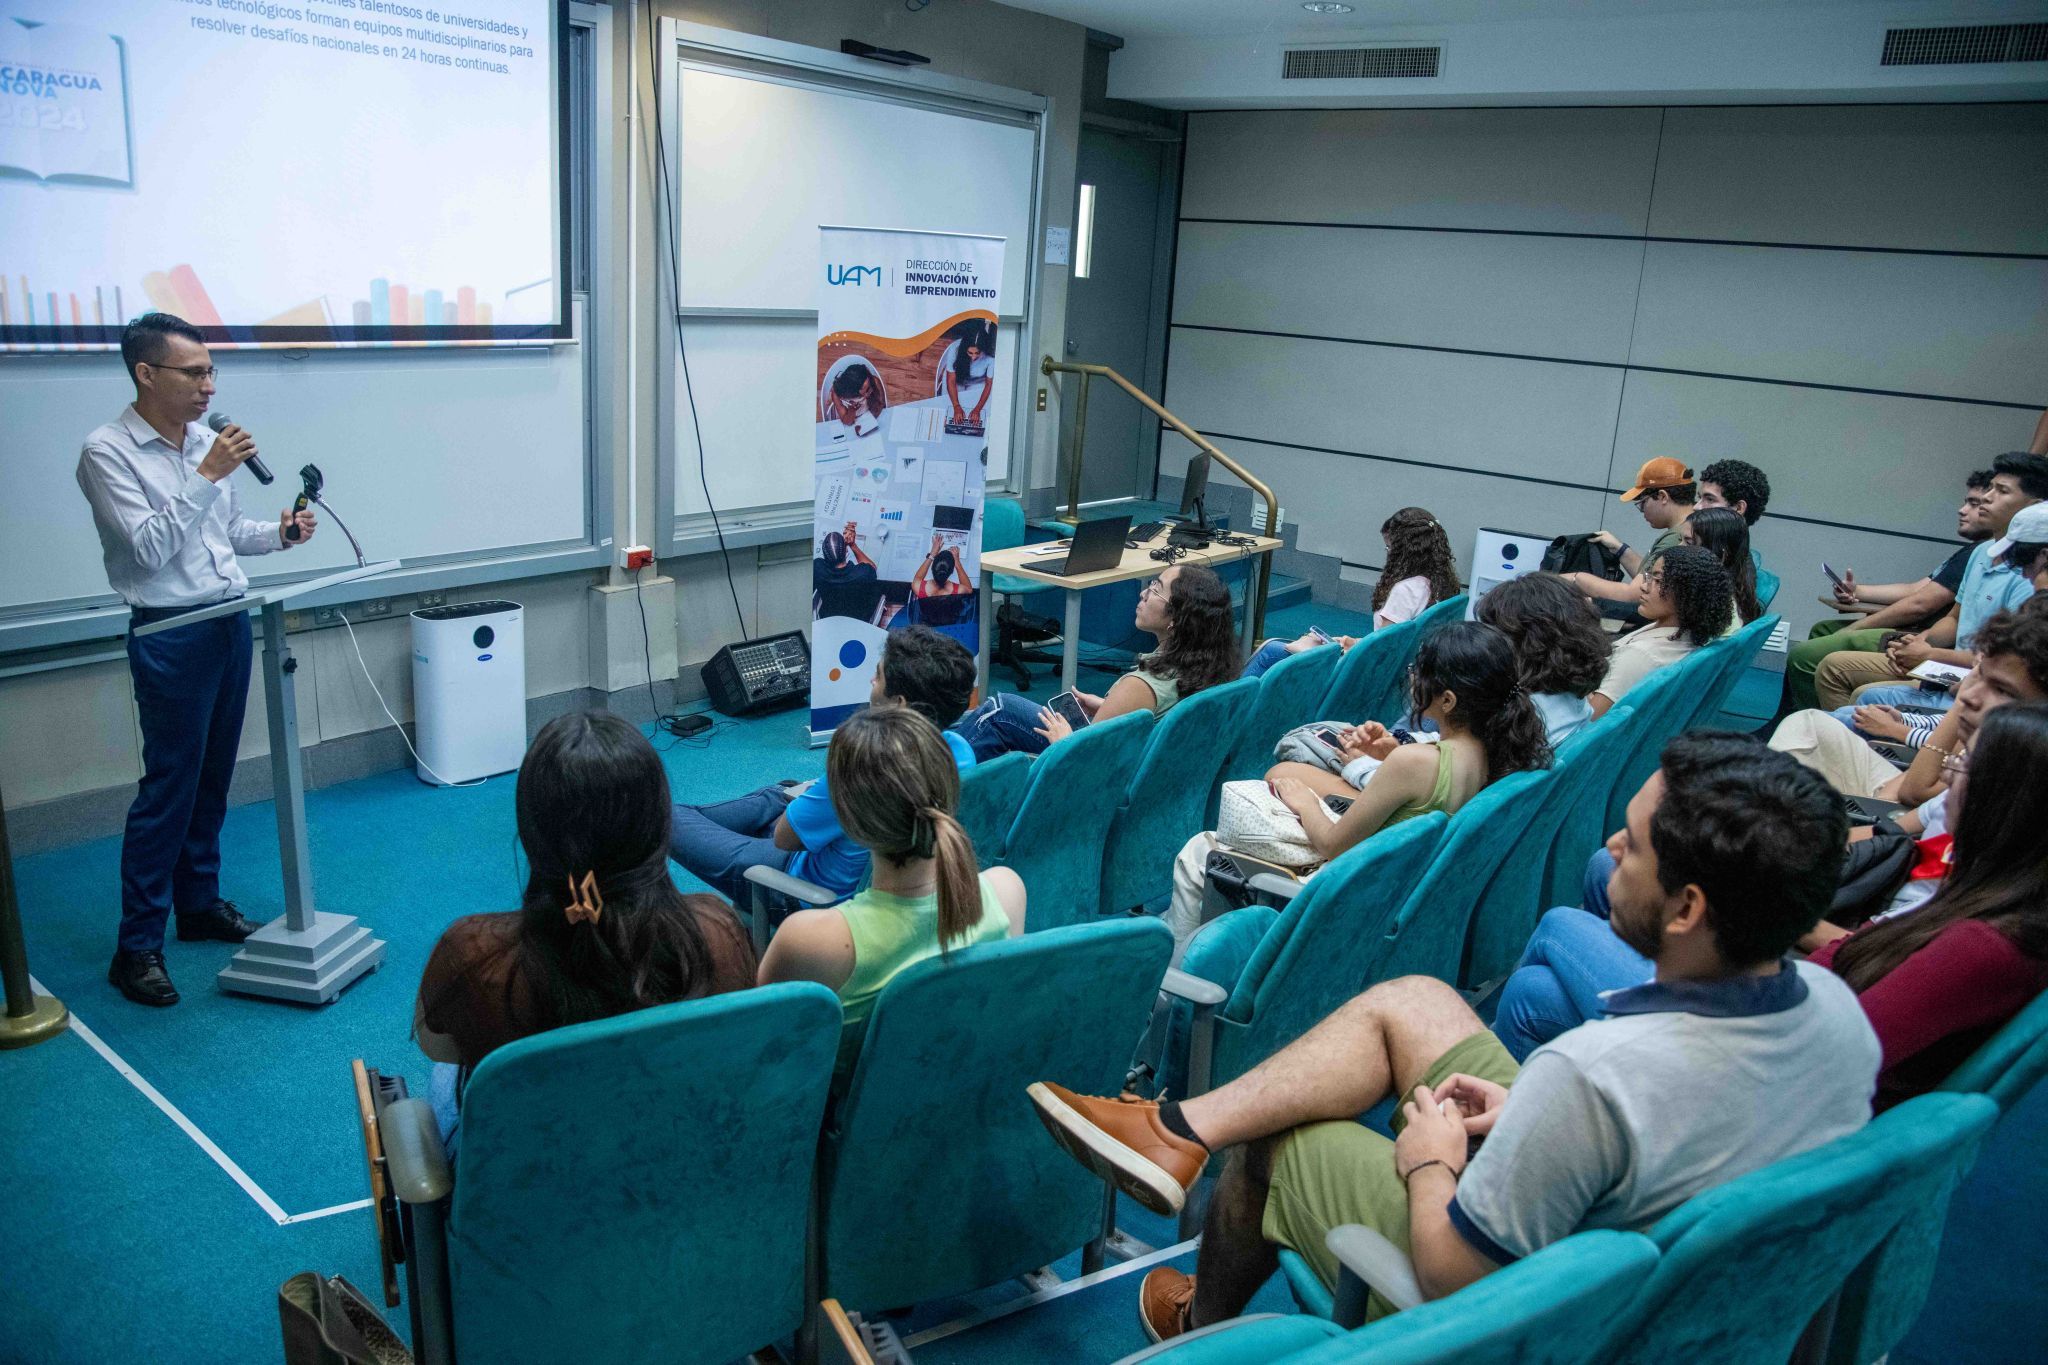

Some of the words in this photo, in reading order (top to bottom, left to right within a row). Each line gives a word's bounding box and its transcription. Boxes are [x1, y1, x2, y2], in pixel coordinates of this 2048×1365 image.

[216, 0, 302, 21] tecnológicos
[306, 9, 350, 29] forman
[353, 20, 403, 37] equipos
[406, 27, 507, 54] multidisciplinarios
[509, 44, 534, 58] para
[359, 0, 423, 20] talentosos
[425, 8, 440, 22] de
[443, 13, 520, 36] universidades
[521, 26, 529, 39] y
[191, 15, 246, 36] resolver
[250, 24, 309, 45] desafíos
[312, 34, 380, 56] nacionales
[382, 45, 398, 58] en
[401, 46, 417, 61] 24
[420, 50, 452, 67] horas
[455, 56, 511, 75] continuas.
[827, 264, 881, 287] UAM
[906, 259, 958, 272] DIRECCIÓN
[959, 262, 974, 273] DE
[905, 272, 970, 285] INNOVACIÓN
[971, 275, 979, 285] Y
[905, 285, 997, 299] EMPRENDIMIENTO
